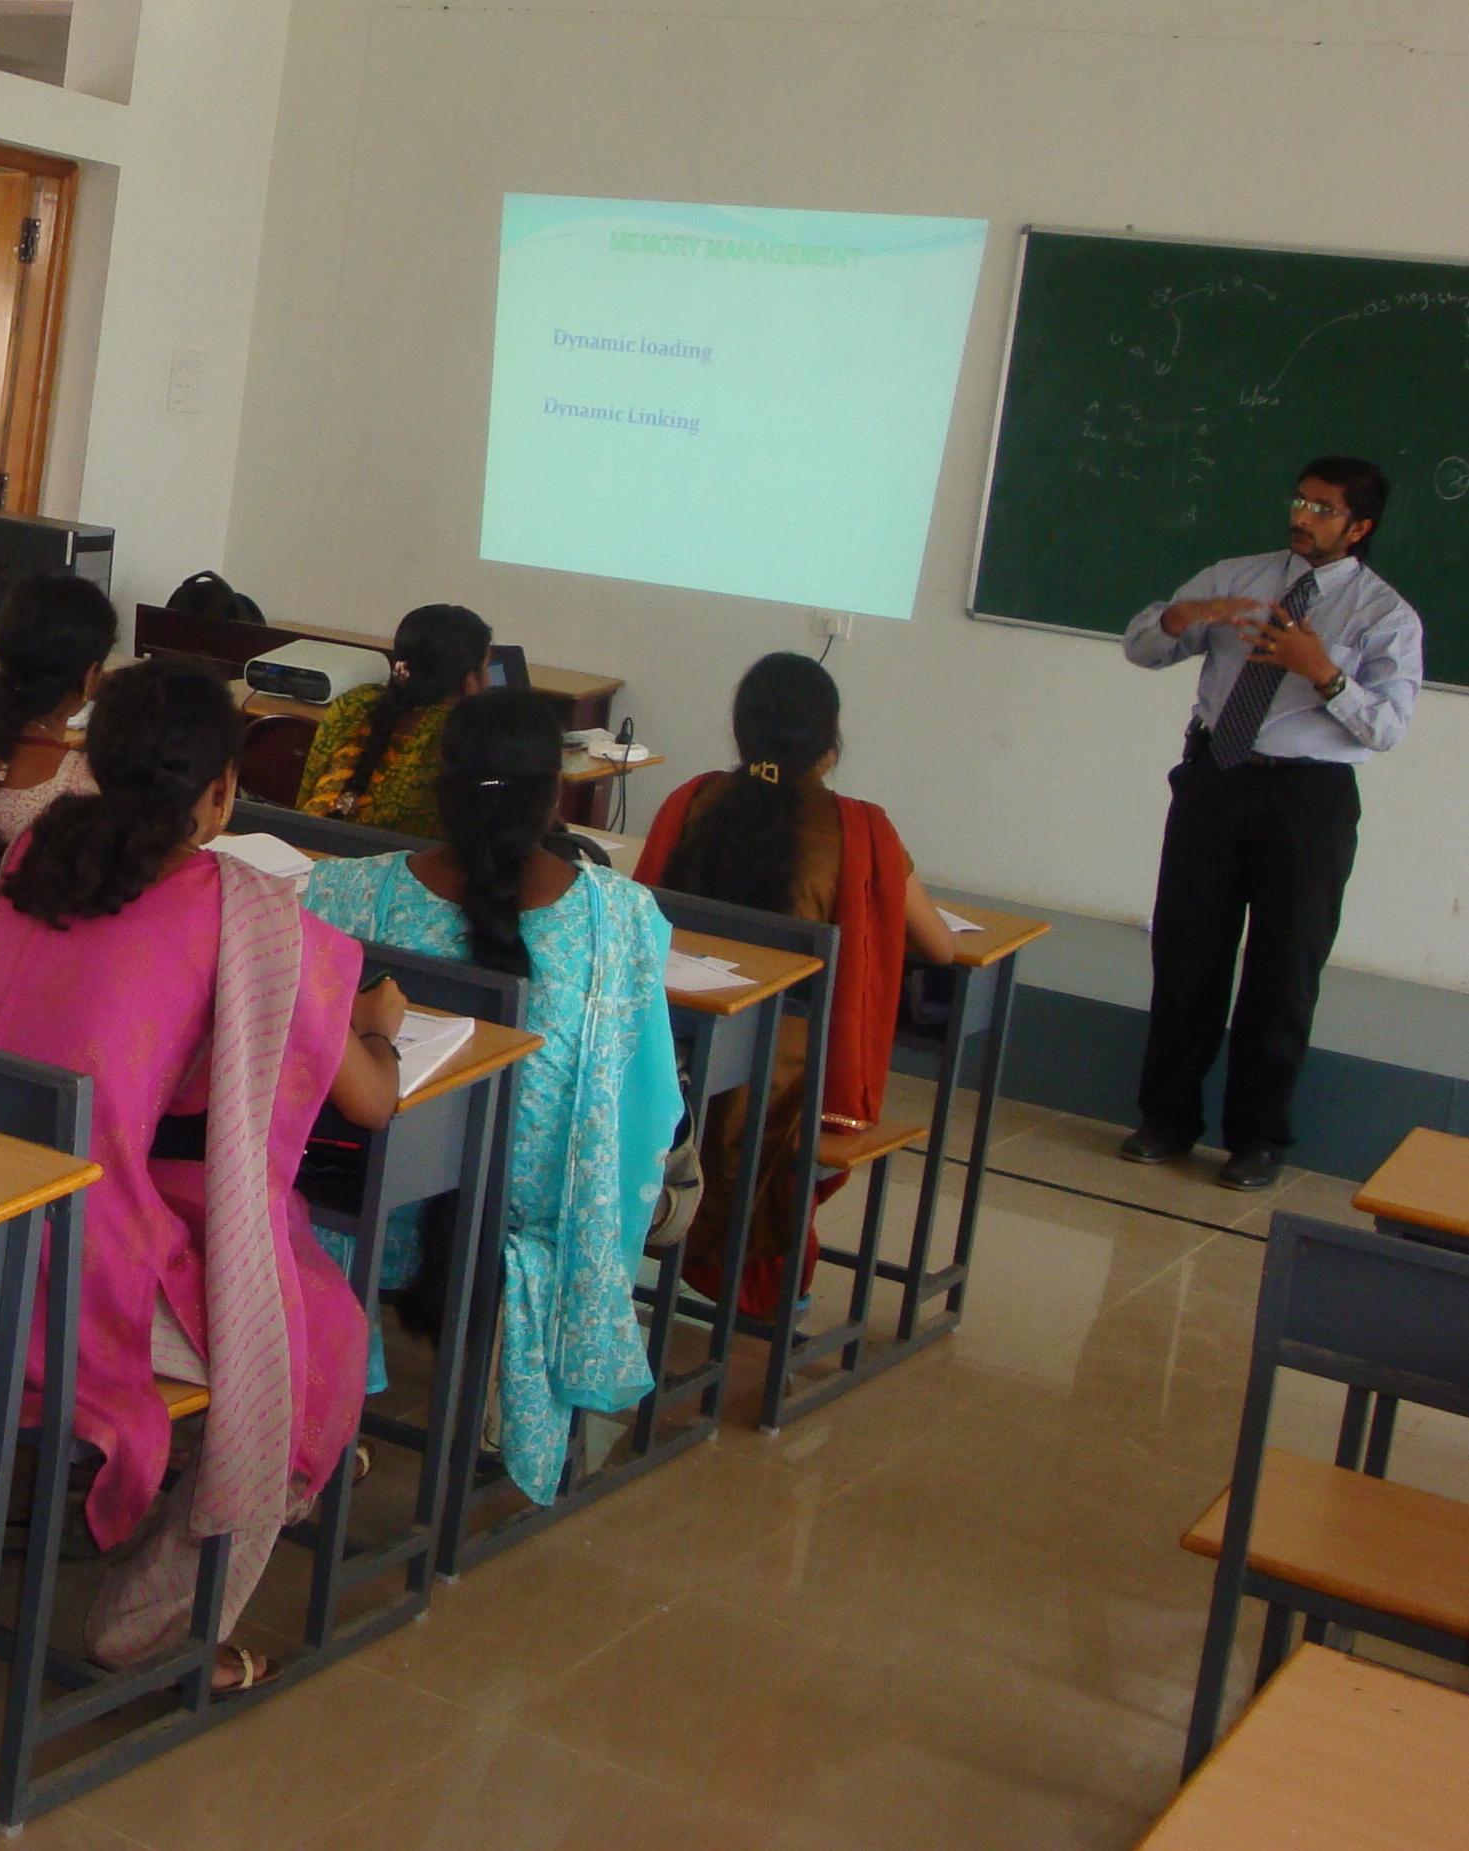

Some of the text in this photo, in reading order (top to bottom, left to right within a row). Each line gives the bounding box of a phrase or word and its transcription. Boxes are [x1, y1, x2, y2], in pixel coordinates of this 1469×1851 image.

[610, 231, 864, 267] MEMORY MANAGEMENT
[553, 328, 714, 364] Dynamic loading
[543, 397, 701, 436] Dynamic Linking
